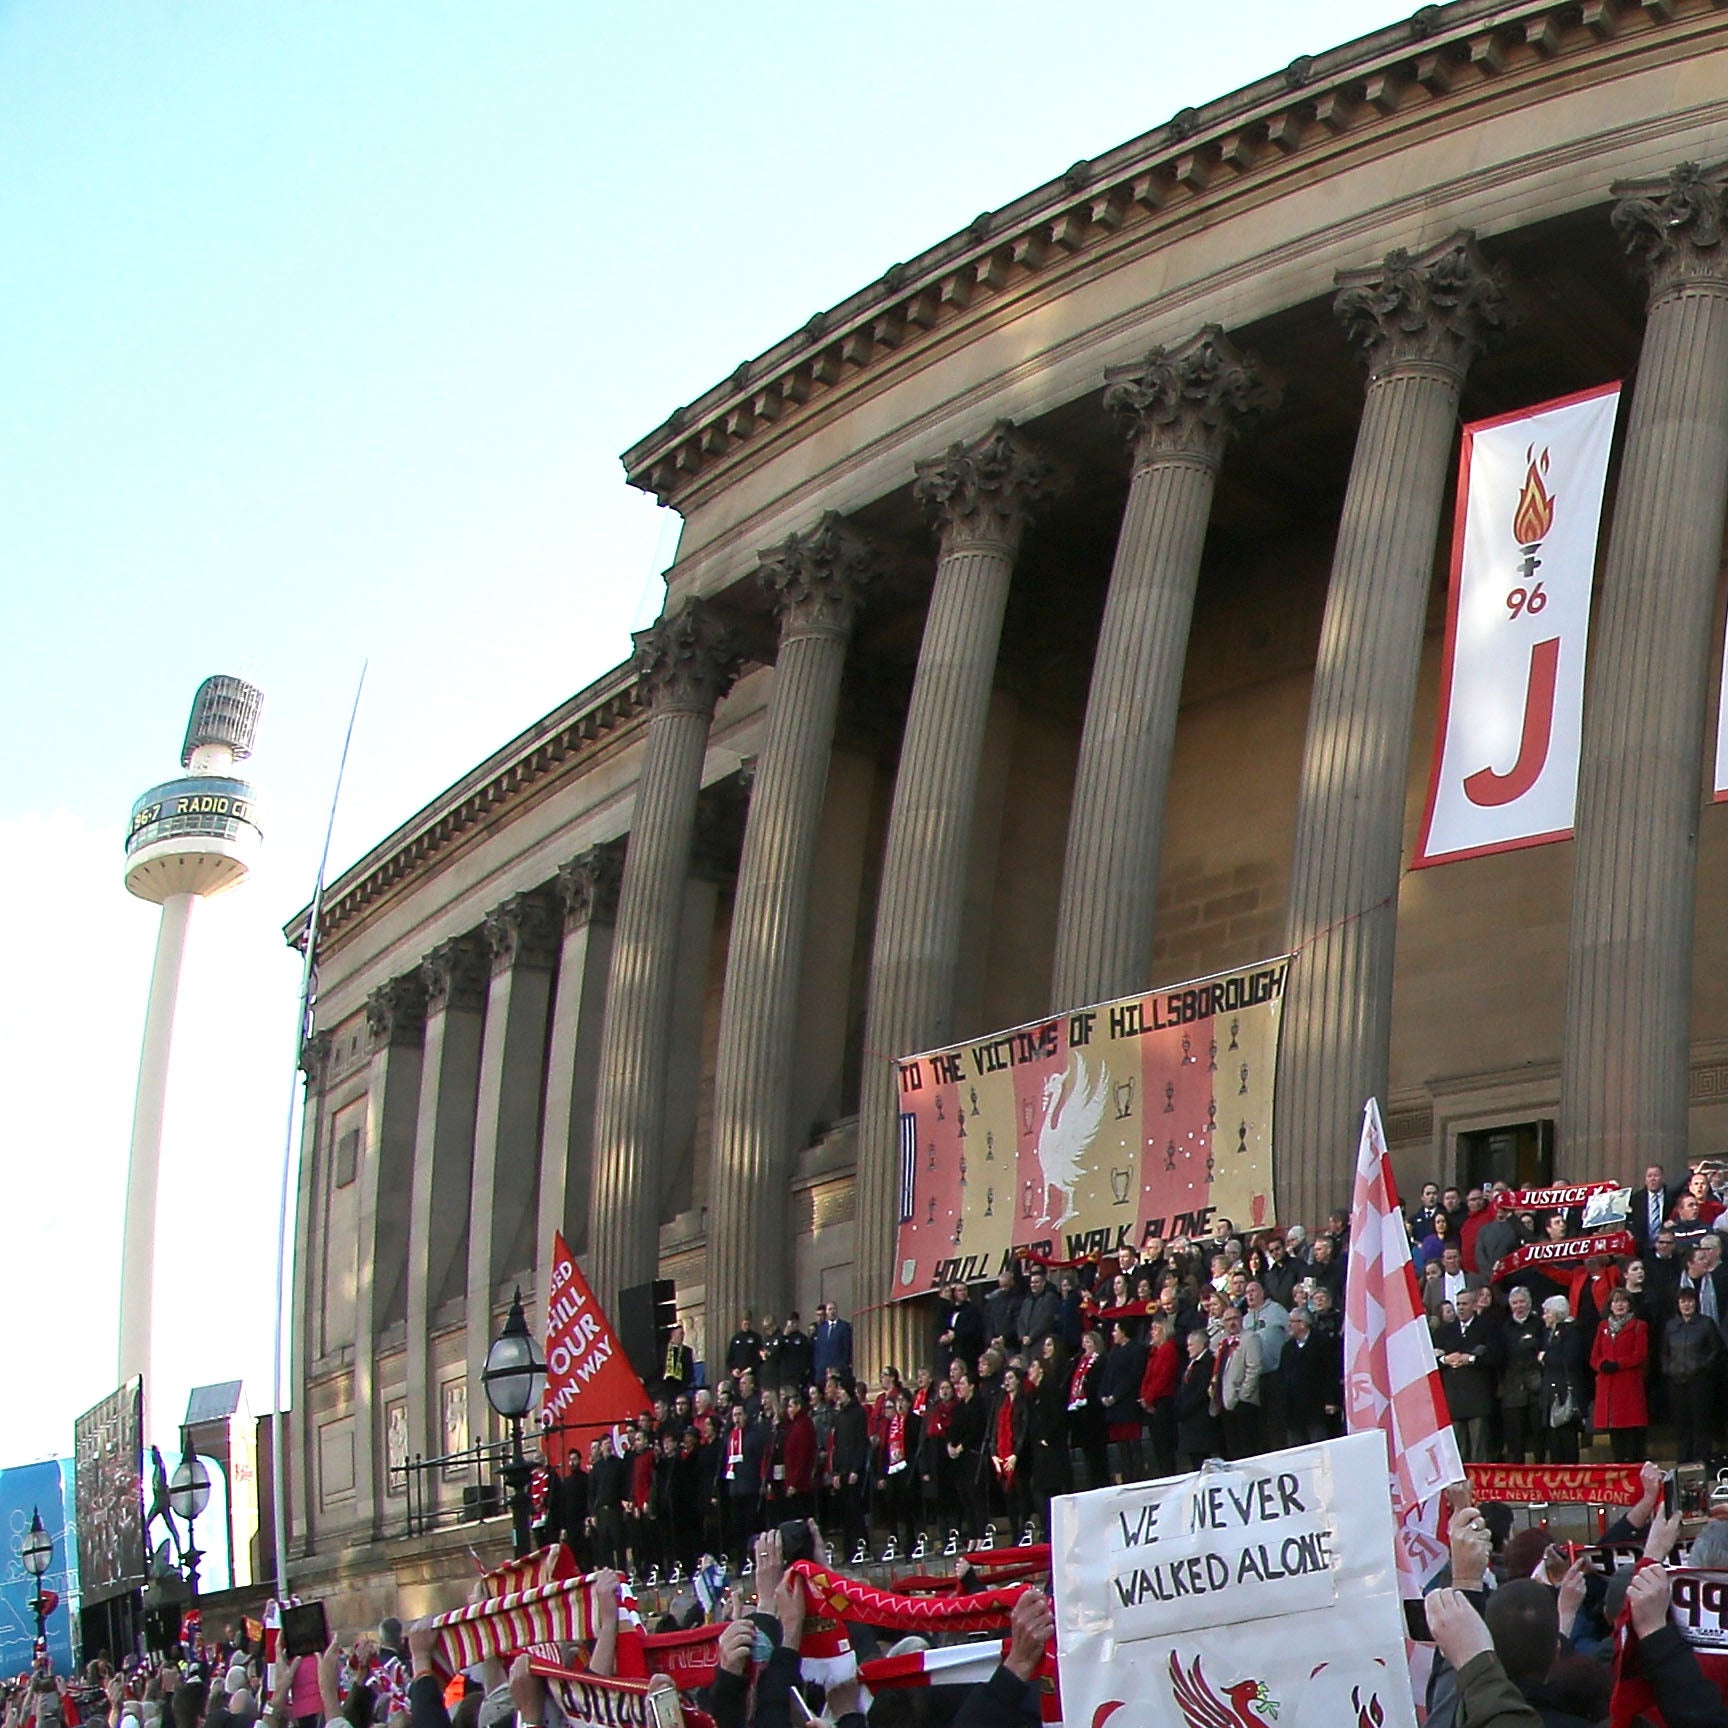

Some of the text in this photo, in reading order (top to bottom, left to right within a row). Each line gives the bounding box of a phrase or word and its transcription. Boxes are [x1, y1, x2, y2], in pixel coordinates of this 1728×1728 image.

[1506, 581, 1547, 621] 96
[178, 797, 228, 814] RADIO
[899, 965, 1287, 1093] TO THE VICTIMS OF HILLSBOROUGH
[1520, 1187, 1586, 1206] JUSTICE
[1523, 1239, 1590, 1262] JUSTICE
[577, 1335, 613, 1383] WAY
[1119, 1472, 1306, 1548] WE NEVER
[1506, 1489, 1632, 1505] NEVER WALK ALONE
[1115, 1531, 1333, 1608] WALKED ALONE
